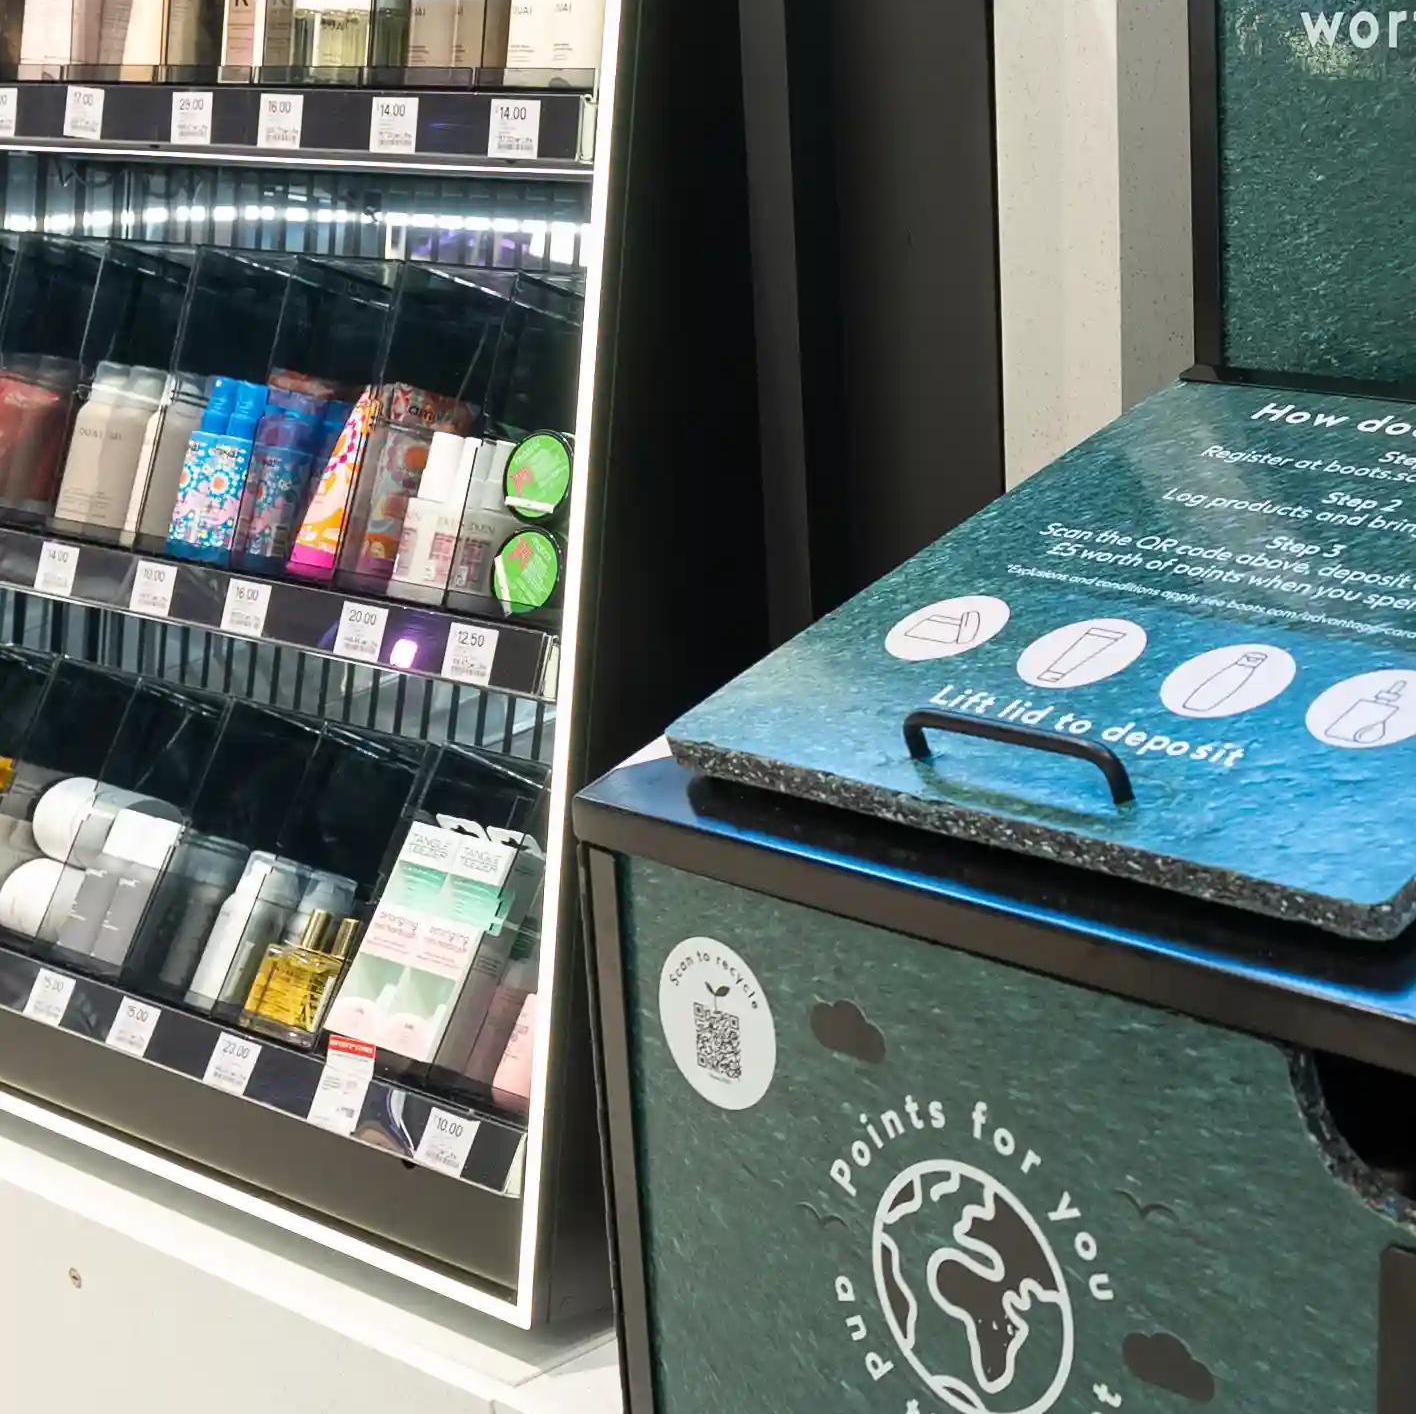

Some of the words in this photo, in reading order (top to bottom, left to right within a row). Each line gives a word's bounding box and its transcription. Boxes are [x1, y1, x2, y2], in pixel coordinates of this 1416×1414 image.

[1251, 402, 1349, 429] How
[1200, 445, 1295, 467] Register
[1294, 458, 1323, 471] at
[1162, 487, 1208, 507] Log
[1204, 496, 1313, 519] products
[1316, 513, 1369, 527] and
[1322, 491, 1379, 512] Step
[1380, 498, 1403, 513] 2
[1039, 522, 1093, 540] Scan
[1095, 528, 1134, 547] the
[1136, 535, 1178, 552] QR
[1176, 545, 1233, 563] code
[1235, 551, 1311, 575] above,
[1317, 563, 1414, 588] deposit
[1046, 542, 1084, 556] £5
[1081, 548, 1143, 568] worth
[1145, 557, 1177, 572] of
[1170, 564, 1245, 584] points
[1248, 572, 1311, 596] when
[1310, 584, 1362, 603] you
[1265, 536, 1321, 558] Step
[1323, 543, 1347, 559] 3
[1068, 575, 1100, 586] and
[1095, 578, 1161, 596] conditions
[929, 684, 994, 714] Lift
[998, 697, 1042, 725] lid
[1053, 712, 1093, 736] to
[1101, 723, 1246, 768] deposit
[669, 956, 694, 987] Scan
[696, 950, 711, 963] to
[715, 955, 759, 1011] recycle
[829, 1094, 946, 1197] points
[971, 1100, 1042, 1174] for
[1046, 1189, 1115, 1302] you
[834, 1274, 895, 1381] and
